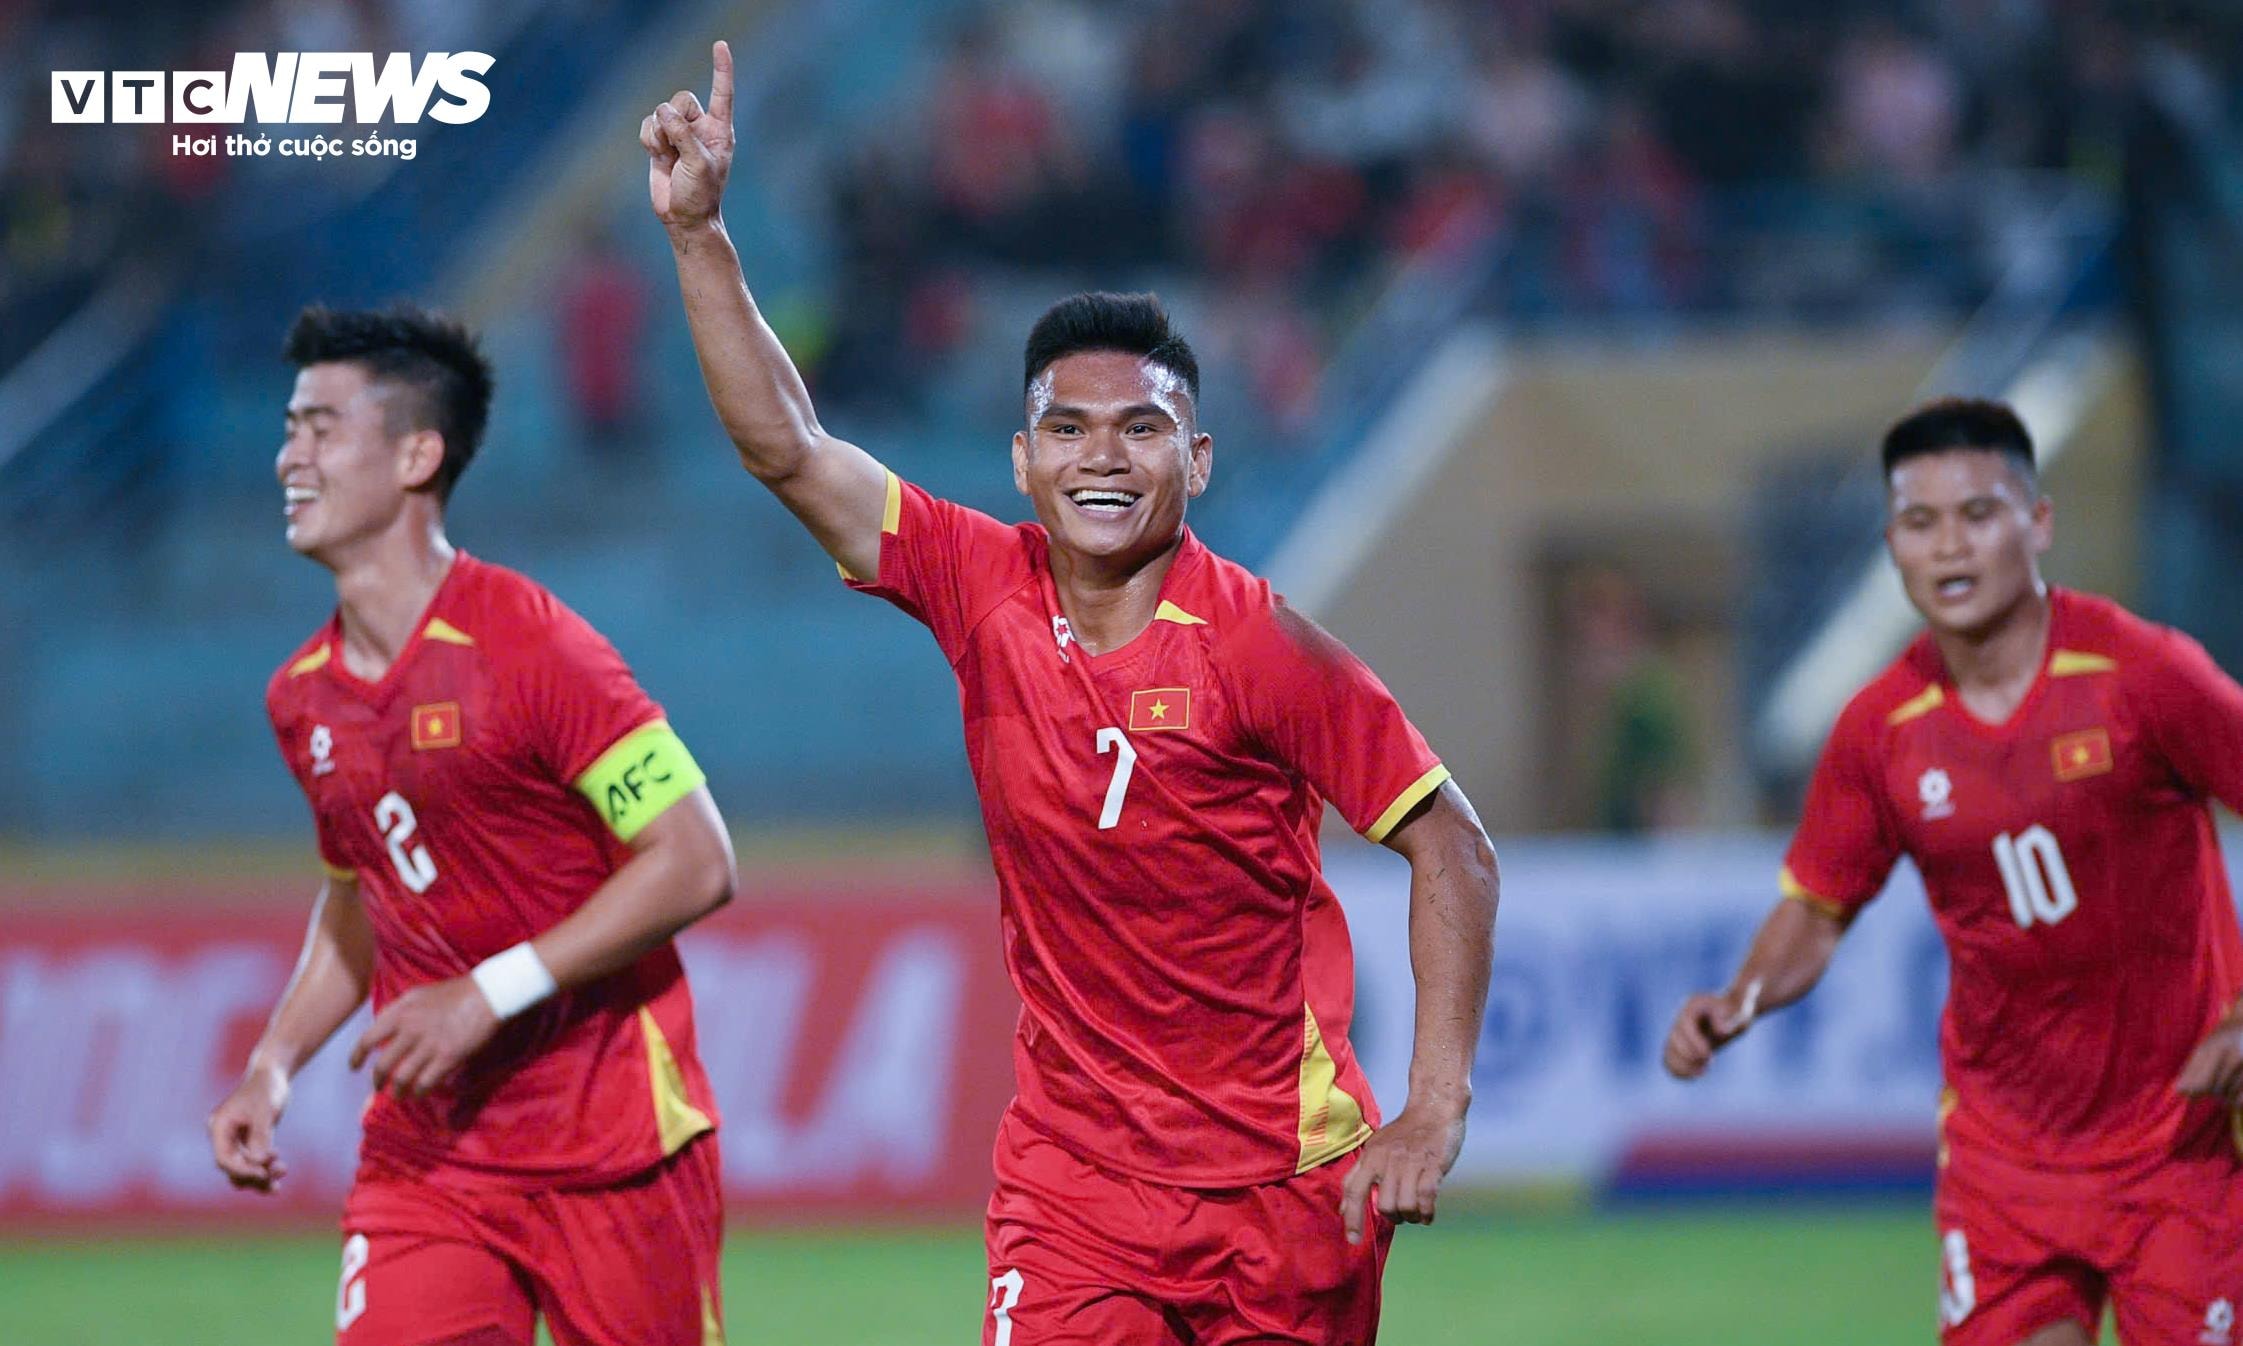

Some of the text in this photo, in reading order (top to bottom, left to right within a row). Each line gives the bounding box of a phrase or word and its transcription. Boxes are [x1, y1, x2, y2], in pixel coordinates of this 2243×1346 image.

[604, 751, 673, 824] AFC
[1096, 726, 1138, 830] 7
[374, 791, 438, 893] 2
[1992, 823, 2079, 930] 10
[336, 1232, 369, 1330] 2
